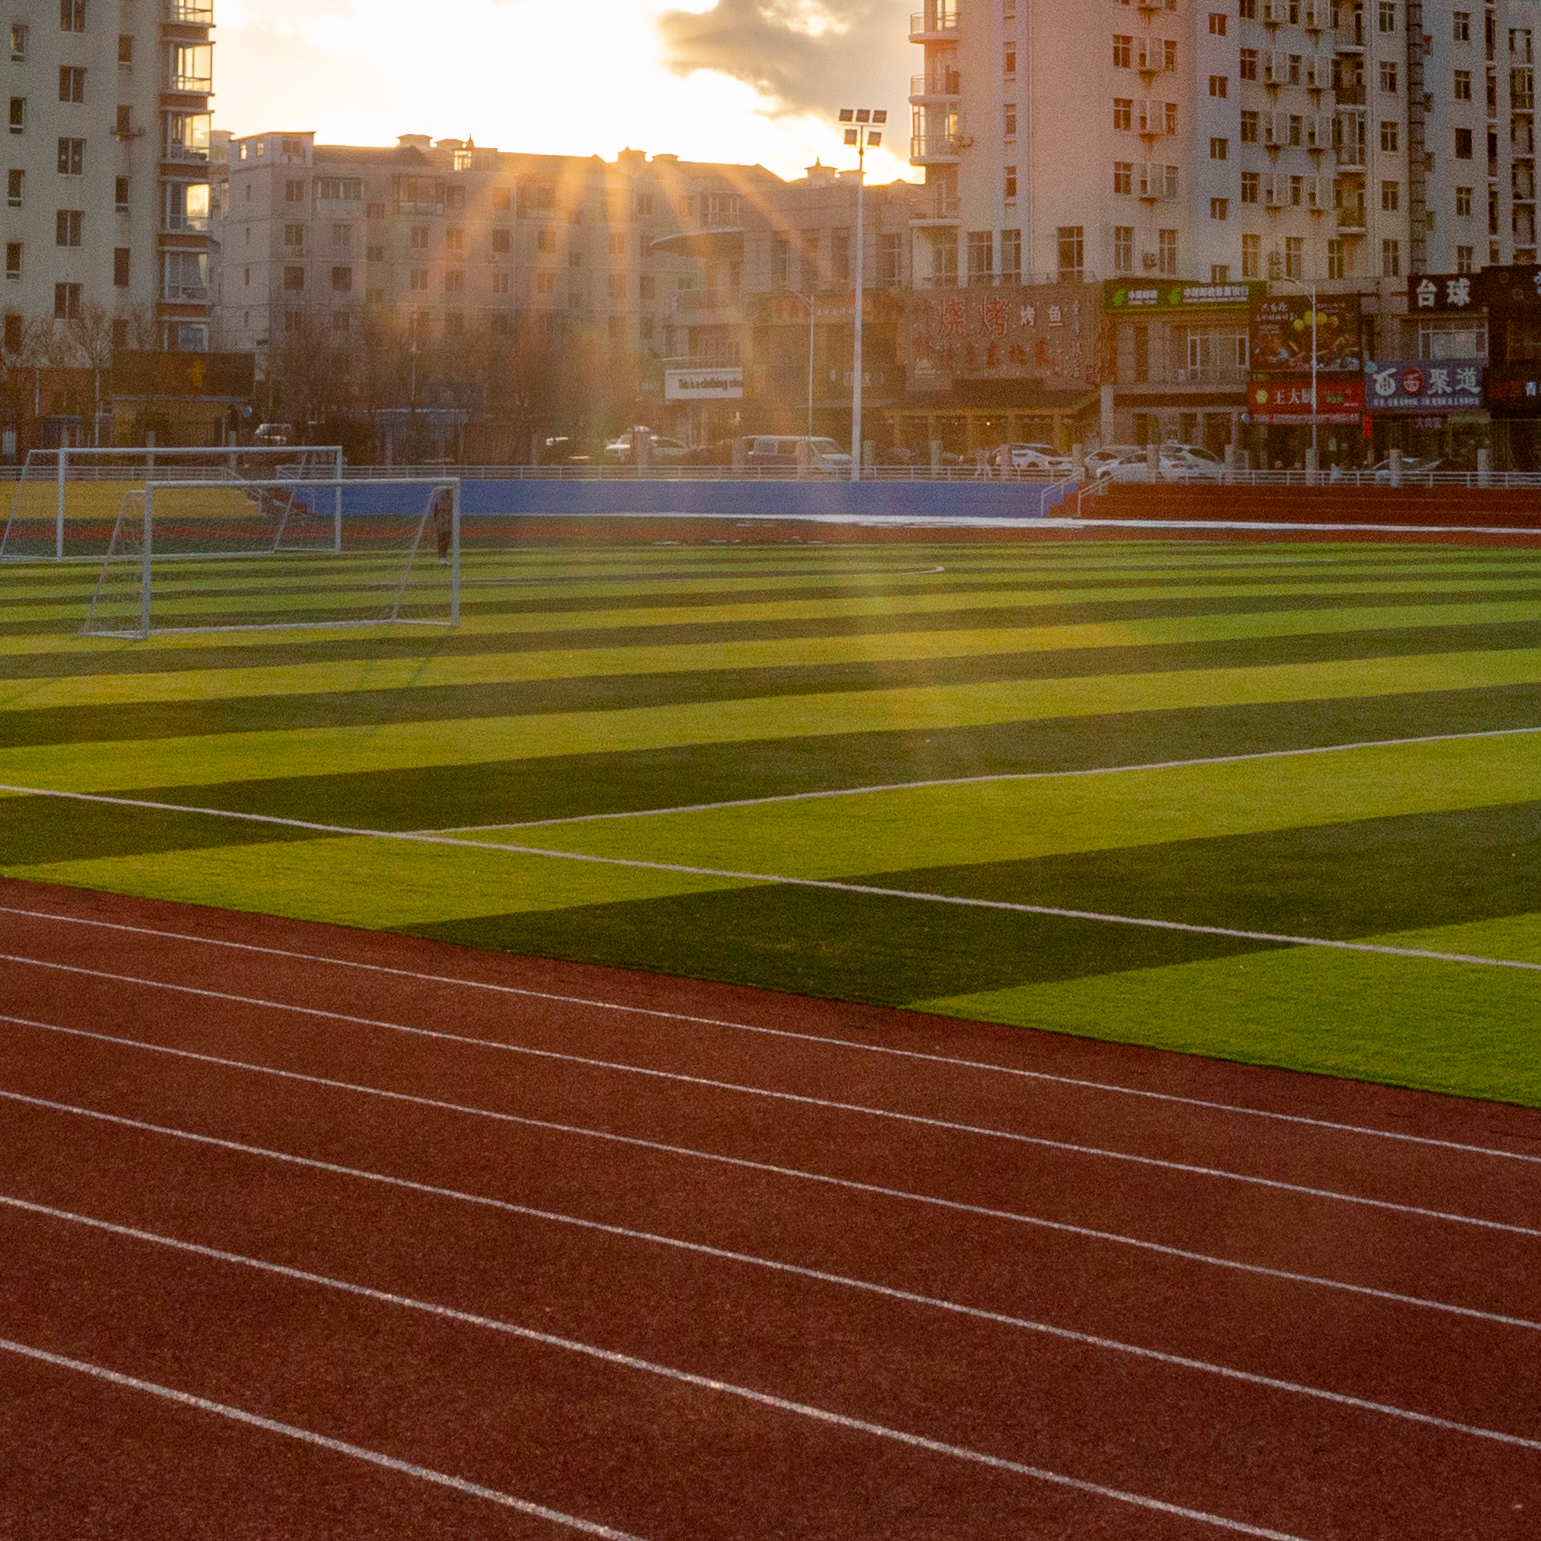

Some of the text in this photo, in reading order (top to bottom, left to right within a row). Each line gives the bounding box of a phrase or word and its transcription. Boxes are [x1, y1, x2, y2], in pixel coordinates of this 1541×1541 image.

[1416, 277, 1471, 307] 台球
[938, 296, 1063, 338] 烧烤 烤鱼
